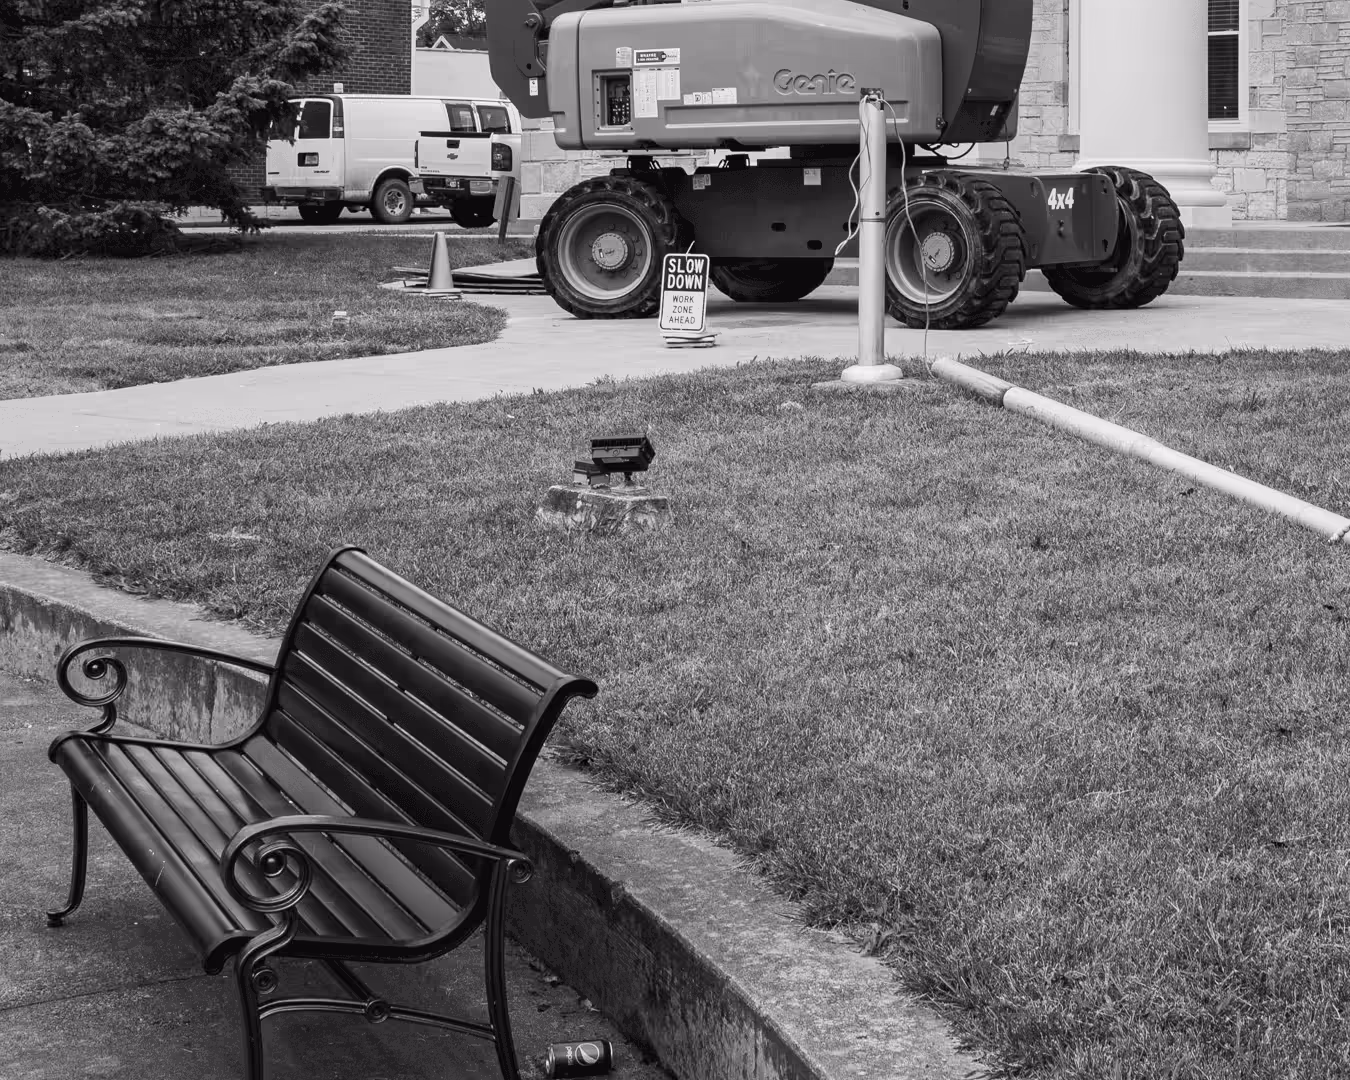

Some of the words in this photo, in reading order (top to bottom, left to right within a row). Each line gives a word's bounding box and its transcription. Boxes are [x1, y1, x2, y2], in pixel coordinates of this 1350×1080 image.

[773, 68, 856, 95] Genie
[1047, 187, 1074, 210] 4x4
[668, 258, 704, 274] SLOW
[667, 274, 703, 290] DOWN
[672, 295, 695, 304] WORK
[672, 305, 693, 314] ZONE
[669, 316, 696, 325] AHEAD
